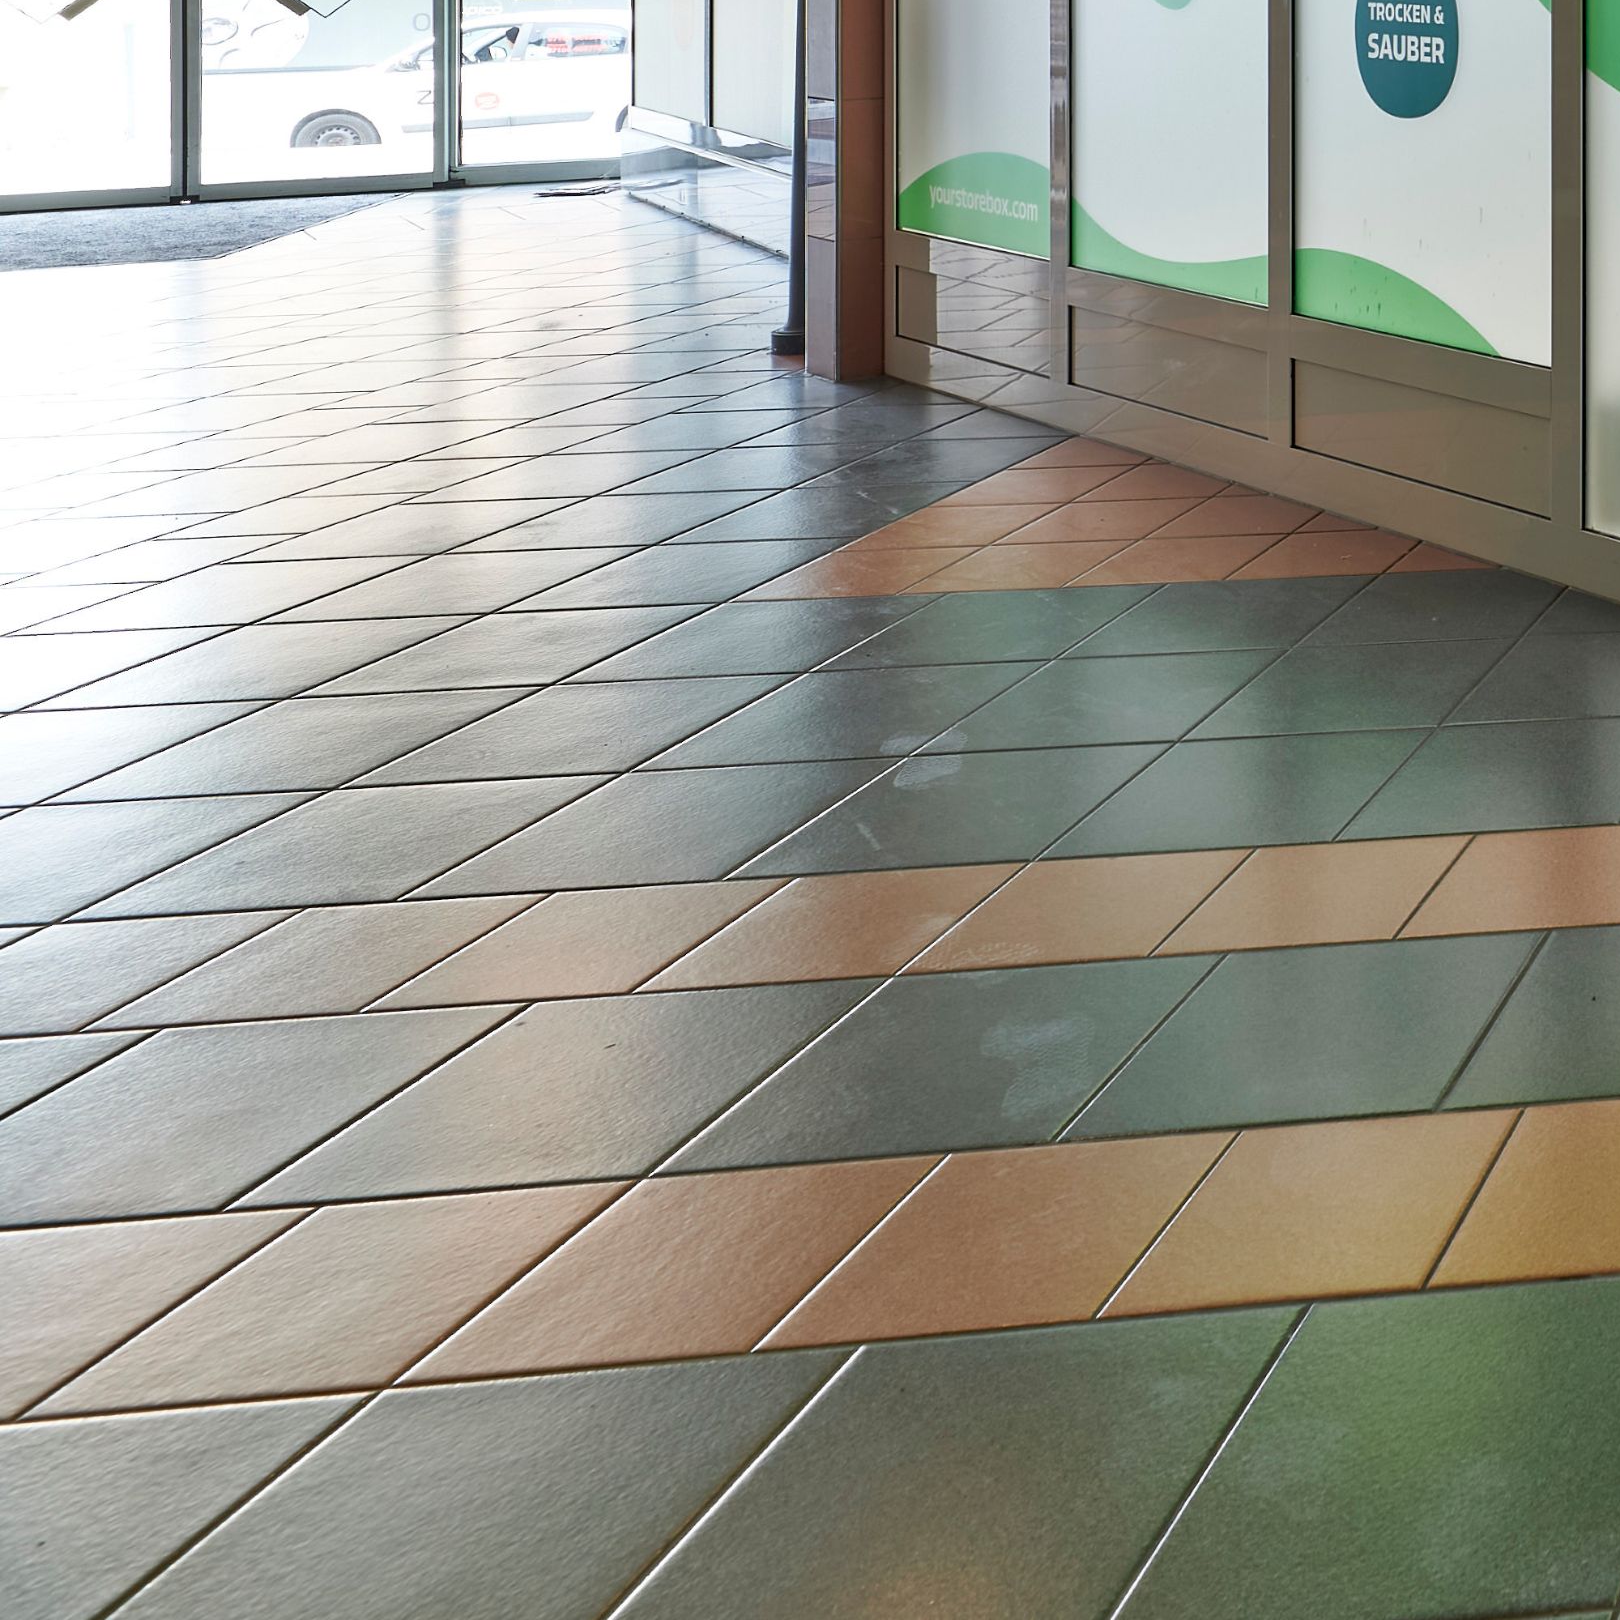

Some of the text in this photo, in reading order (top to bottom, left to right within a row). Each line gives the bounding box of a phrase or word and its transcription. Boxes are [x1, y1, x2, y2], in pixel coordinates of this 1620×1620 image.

[1368, 3, 1444, 24] TROCKEN &
[1368, 33, 1444, 63] SAUBER
[929, 182, 1038, 223] yourstorebox.com
